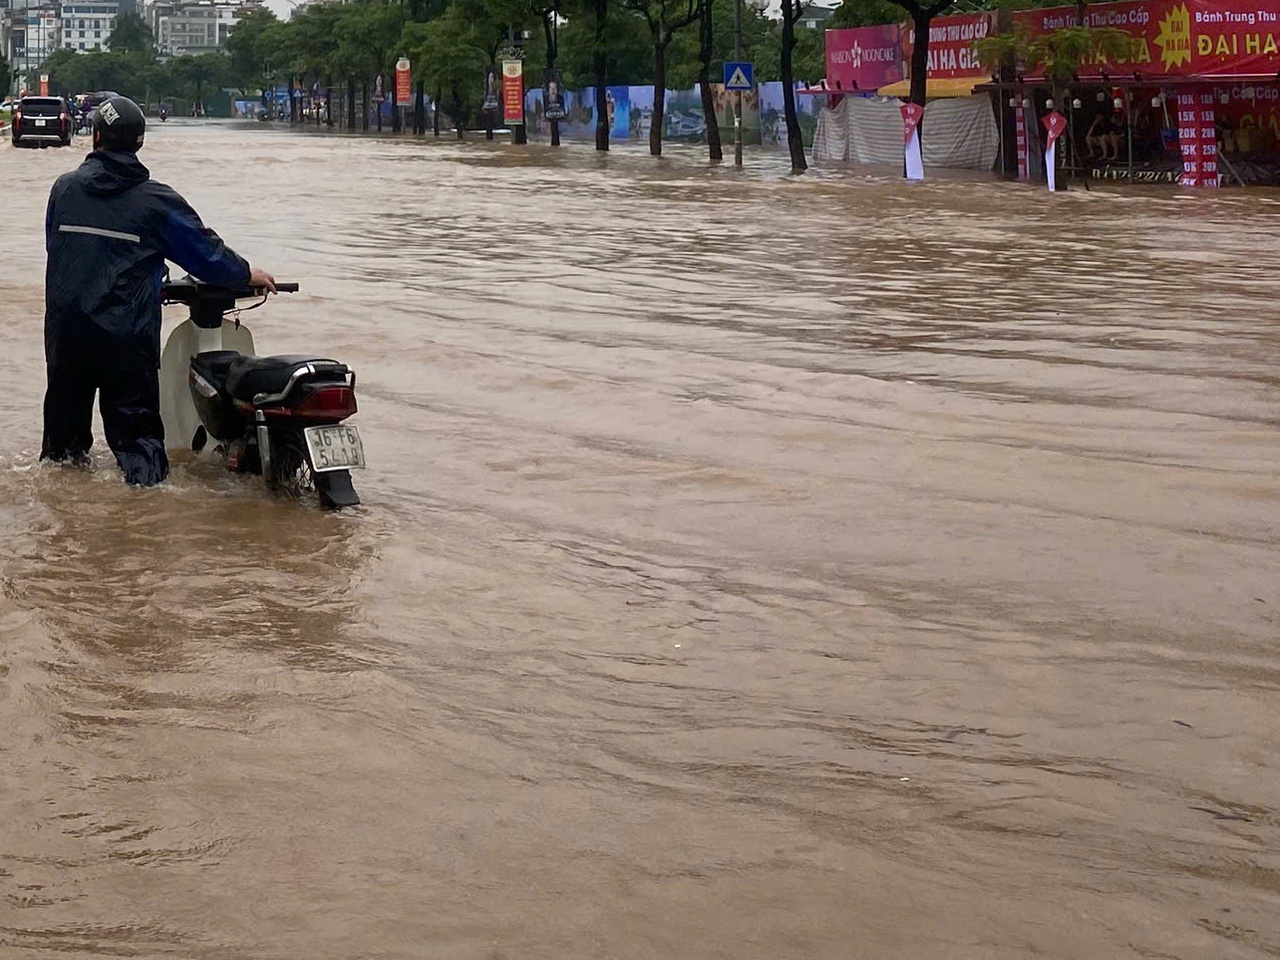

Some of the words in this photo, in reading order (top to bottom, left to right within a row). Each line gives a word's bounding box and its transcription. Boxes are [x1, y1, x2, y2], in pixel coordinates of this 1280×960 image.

[1195, 11, 1223, 22] Bánh
[1225, 11, 1255, 24] Trung
[1257, 10, 1277, 21] Thu
[1197, 33, 1238, 61] ĐẠI
[1246, 33, 1279, 60] HẠ
[1177, 94, 1194, 104] 10K
[1178, 111, 1195, 121] 15K
[1178, 127, 1196, 138] 20K
